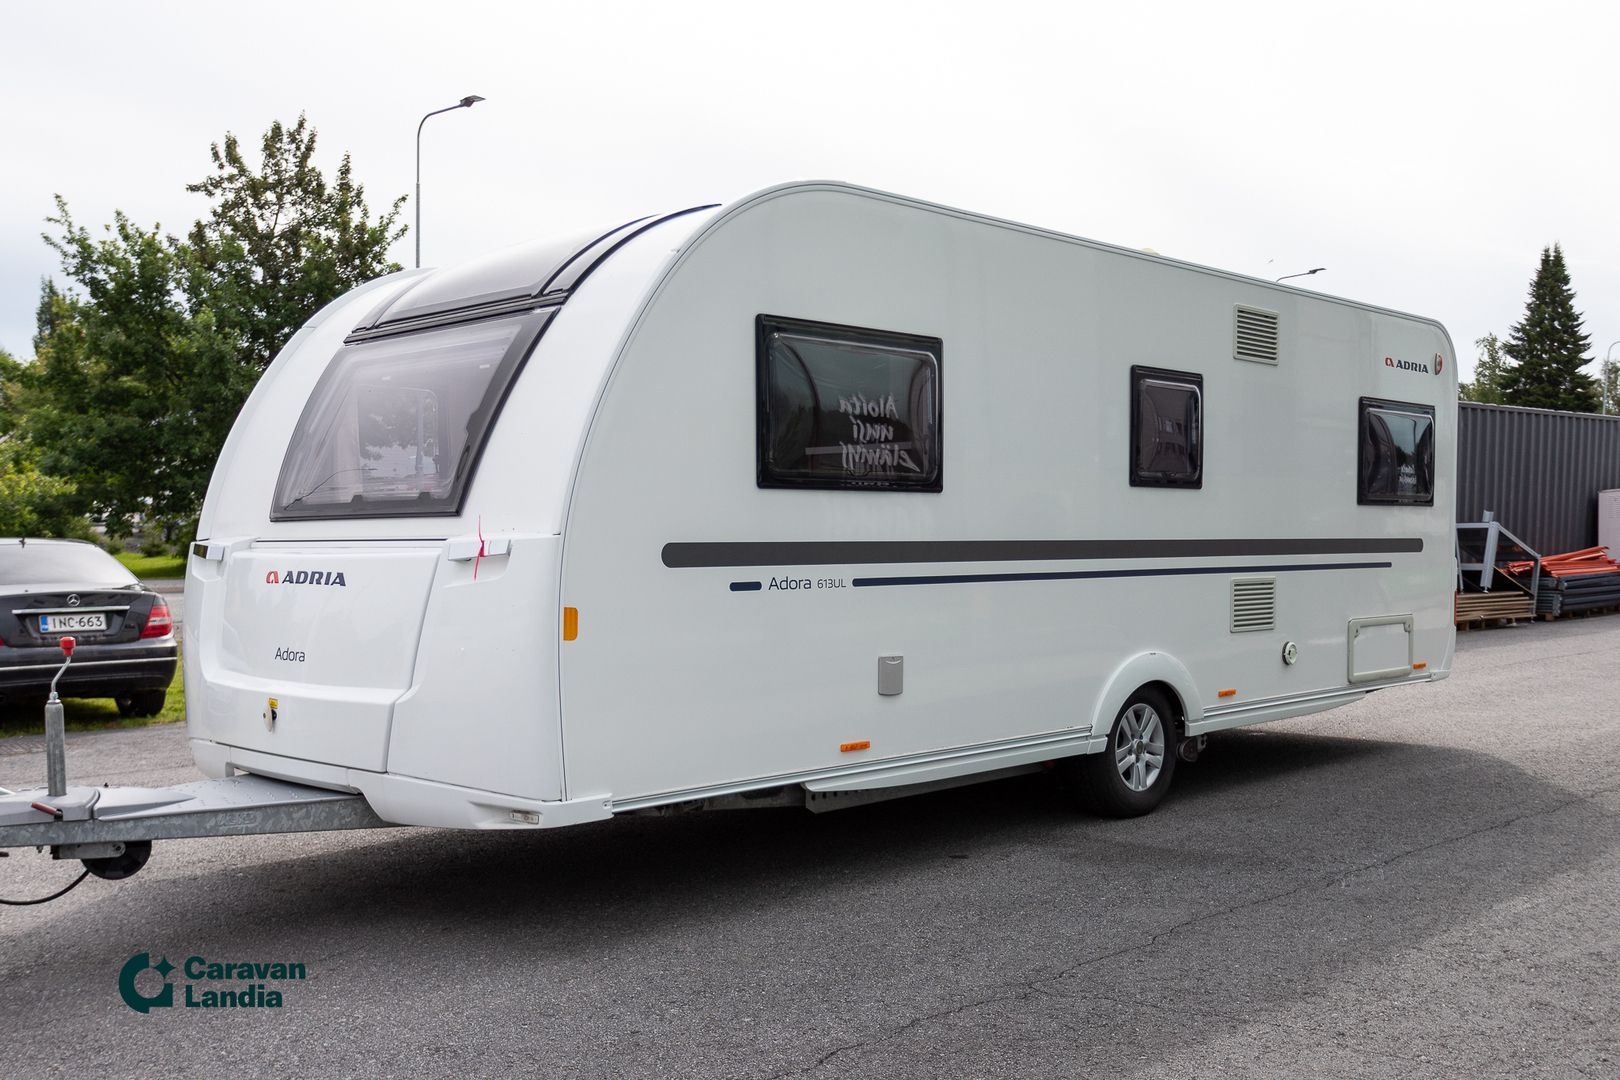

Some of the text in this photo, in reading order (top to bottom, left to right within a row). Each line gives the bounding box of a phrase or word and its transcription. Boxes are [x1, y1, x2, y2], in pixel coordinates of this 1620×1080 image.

[1396, 359, 1429, 374] ADRIA
[281, 570, 347, 587] ADRIA
[768, 576, 847, 590] Adora 613UL
[52, 616, 103, 629] INC-663
[274, 647, 306, 662] Adora
